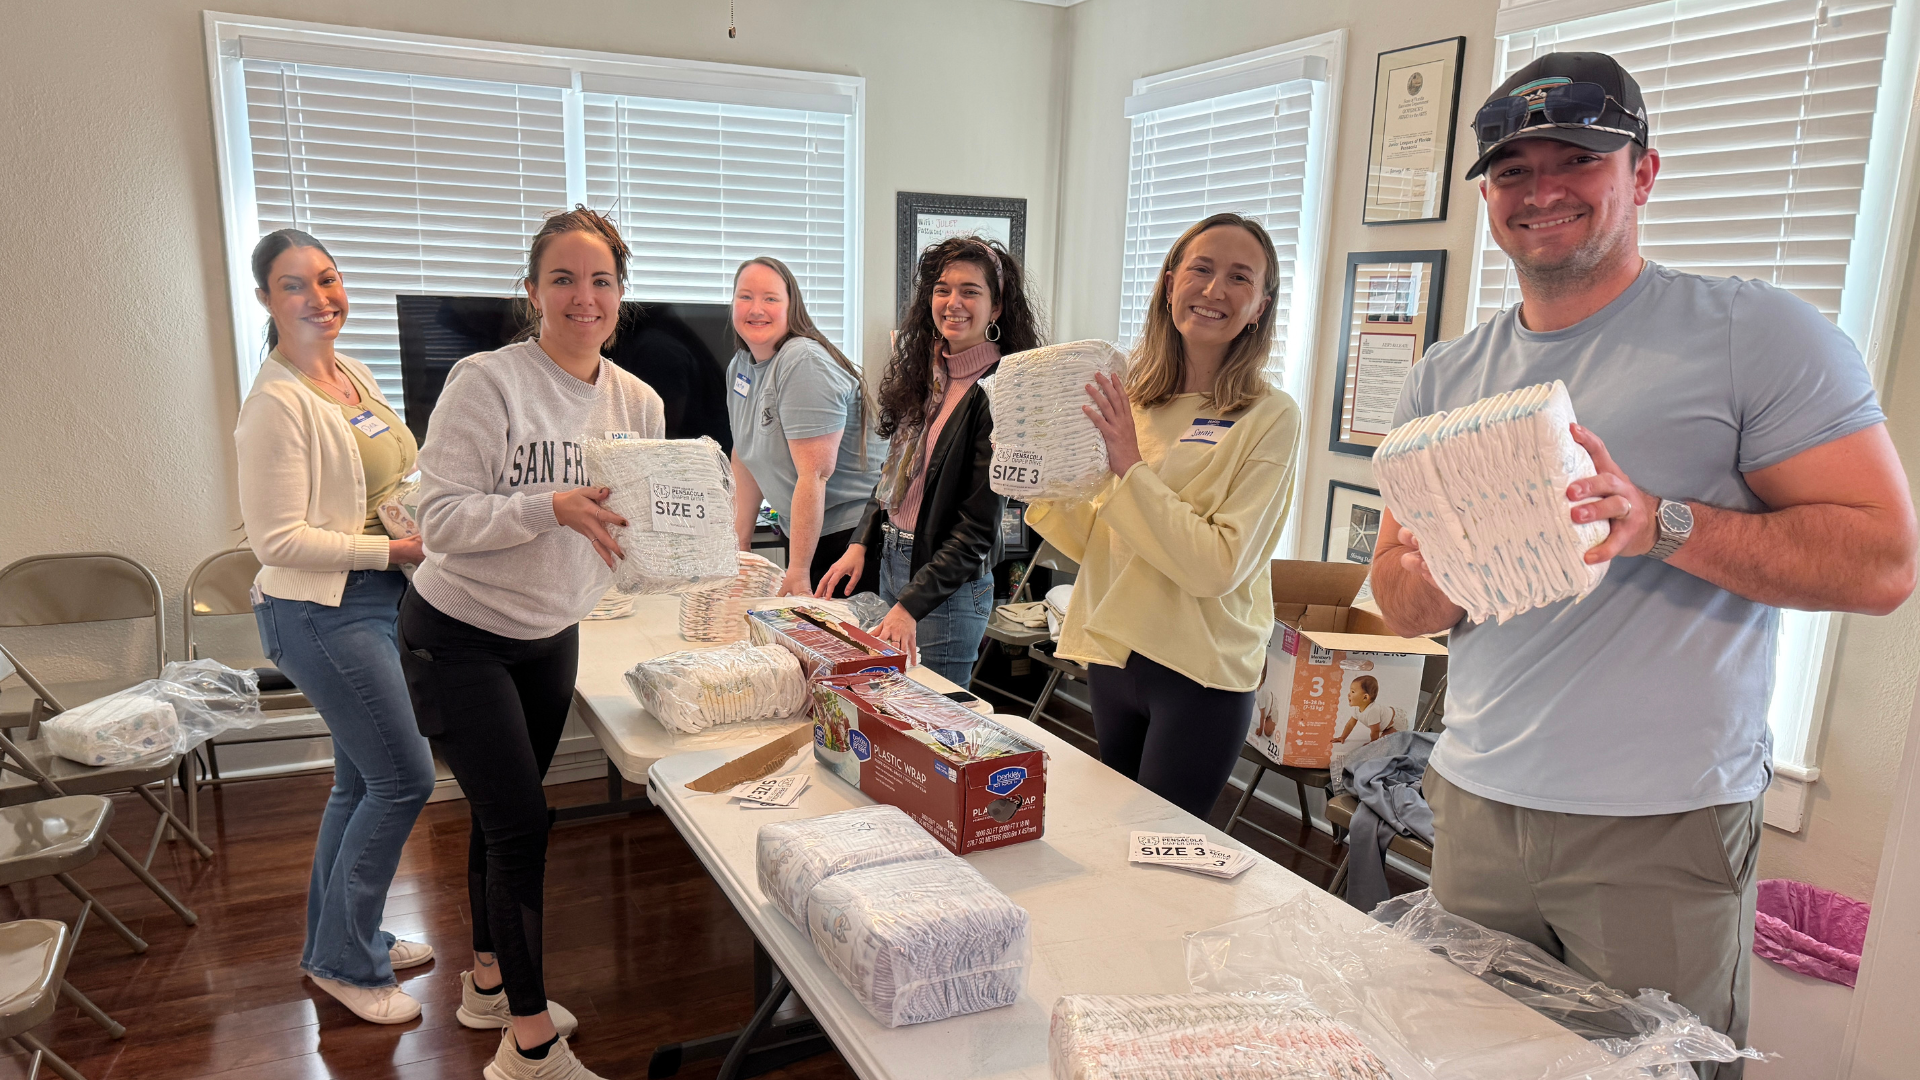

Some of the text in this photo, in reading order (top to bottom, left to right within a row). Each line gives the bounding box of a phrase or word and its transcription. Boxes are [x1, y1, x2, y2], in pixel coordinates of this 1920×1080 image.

[1012, 452, 1043, 461] PENSACOLA
[509, 440, 591, 488] SAN FR
[992, 464, 1040, 485] SIZE 3
[672, 489, 704, 497] PENSACOLA
[655, 500, 706, 519] SIZE 3
[1309, 676, 1325, 698] 3
[873, 744, 902, 771] PLASTIC
[904, 761, 927, 784] WRAP
[997, 771, 1021, 781] berkley
[985, 834, 1001, 842] METERS
[1141, 847, 1206, 856] SIZE 3
